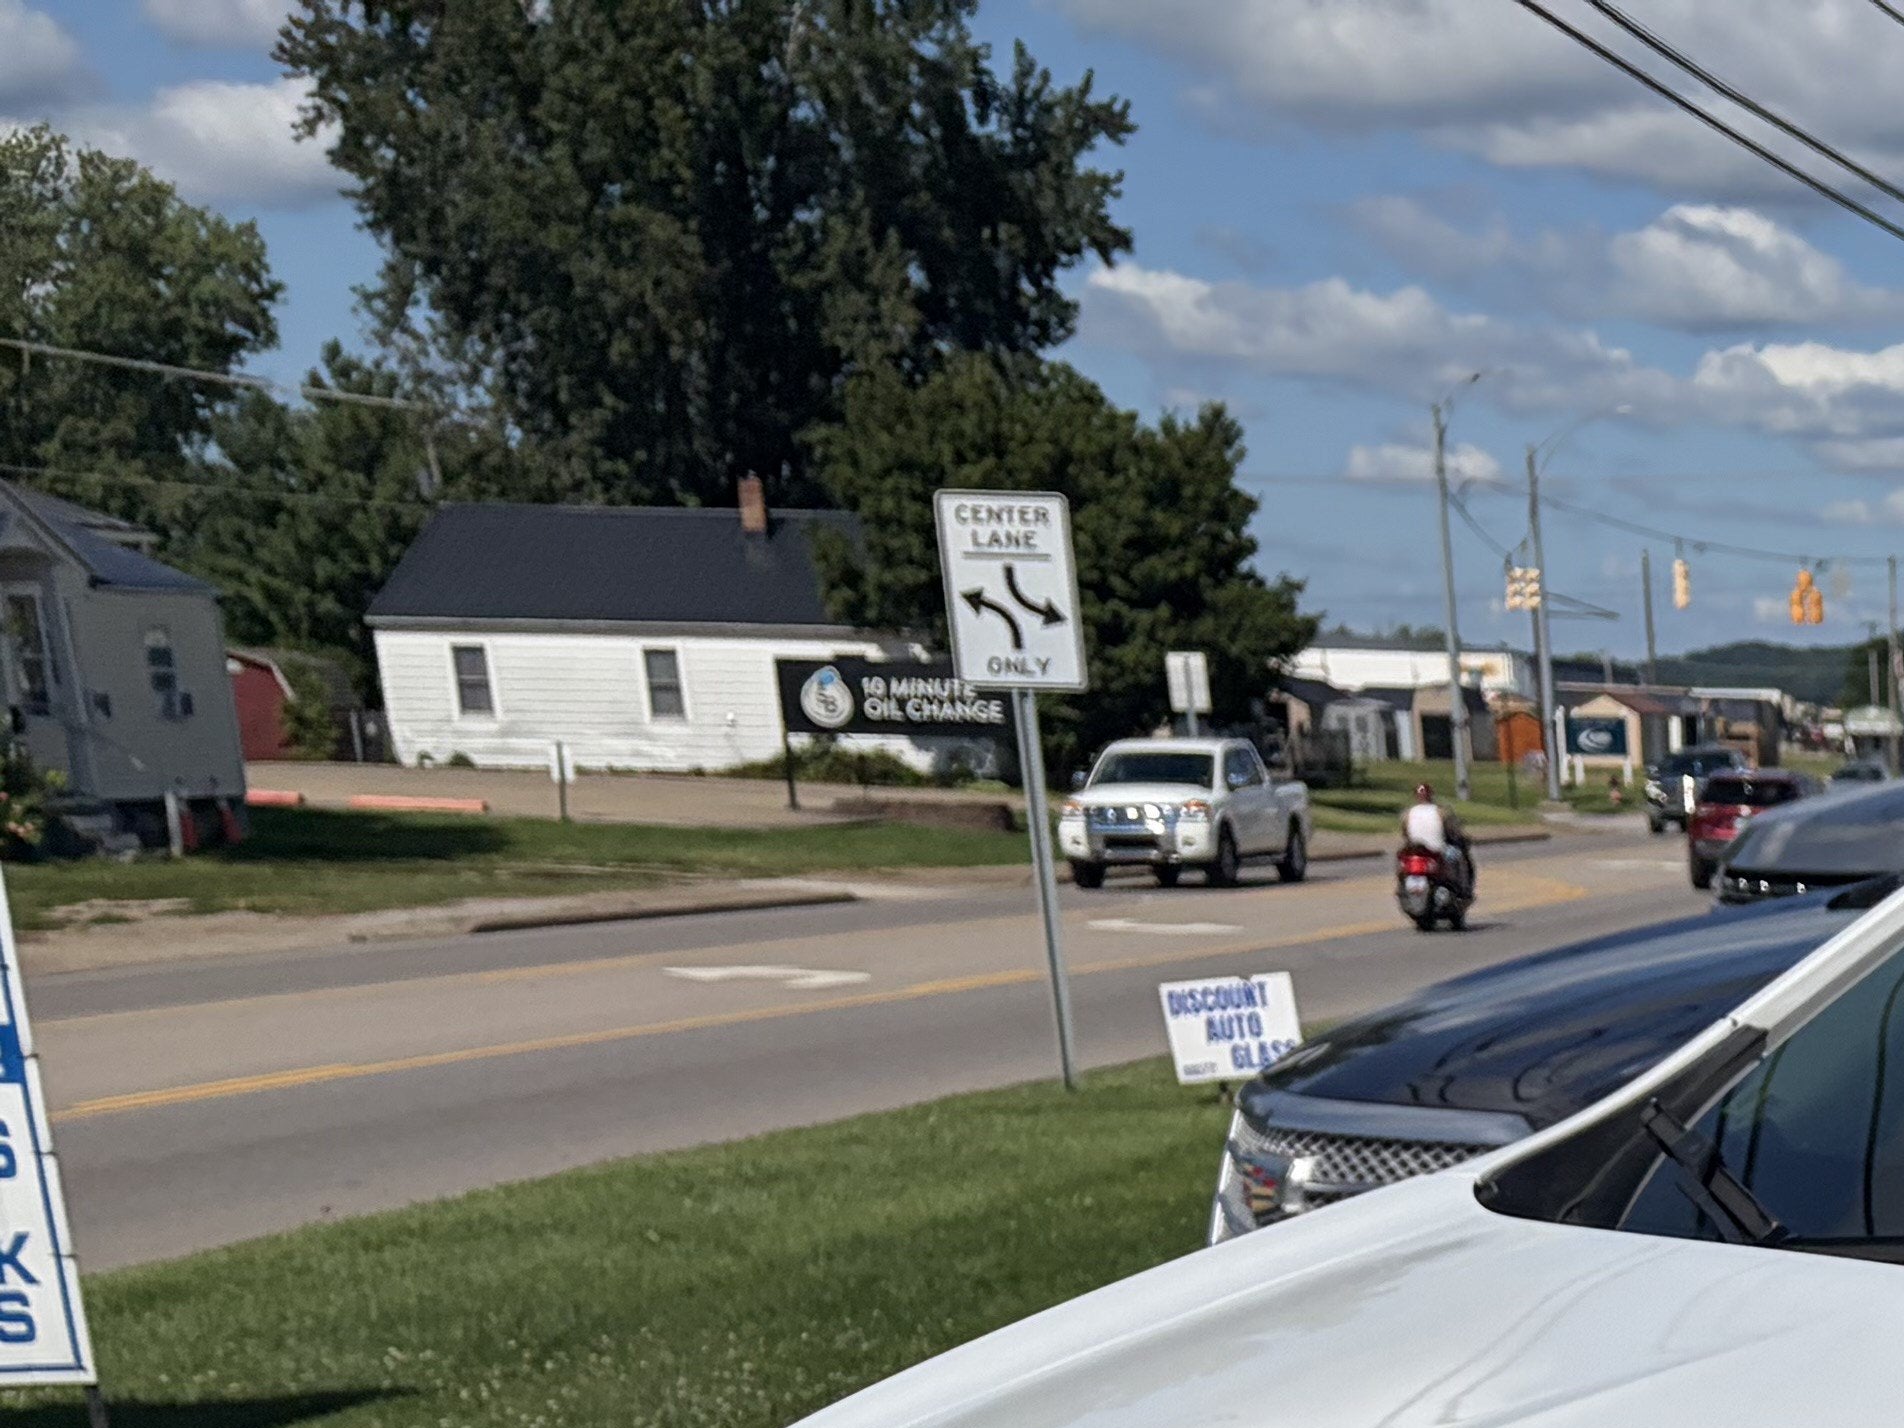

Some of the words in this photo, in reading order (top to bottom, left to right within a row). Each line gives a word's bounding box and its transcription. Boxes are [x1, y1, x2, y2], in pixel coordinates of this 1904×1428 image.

[955, 504, 1050, 526] CENTER
[971, 529, 1038, 549] LANE
[986, 656, 1050, 676] ONLY
[861, 676, 888, 699] 10
[889, 676, 977, 700] MINUTE
[863, 698, 905, 721] OIL
[905, 698, 1005, 724] CHANGE
[1168, 981, 1268, 1015] DISCOUNT
[1206, 1011, 1263, 1041] AUTO
